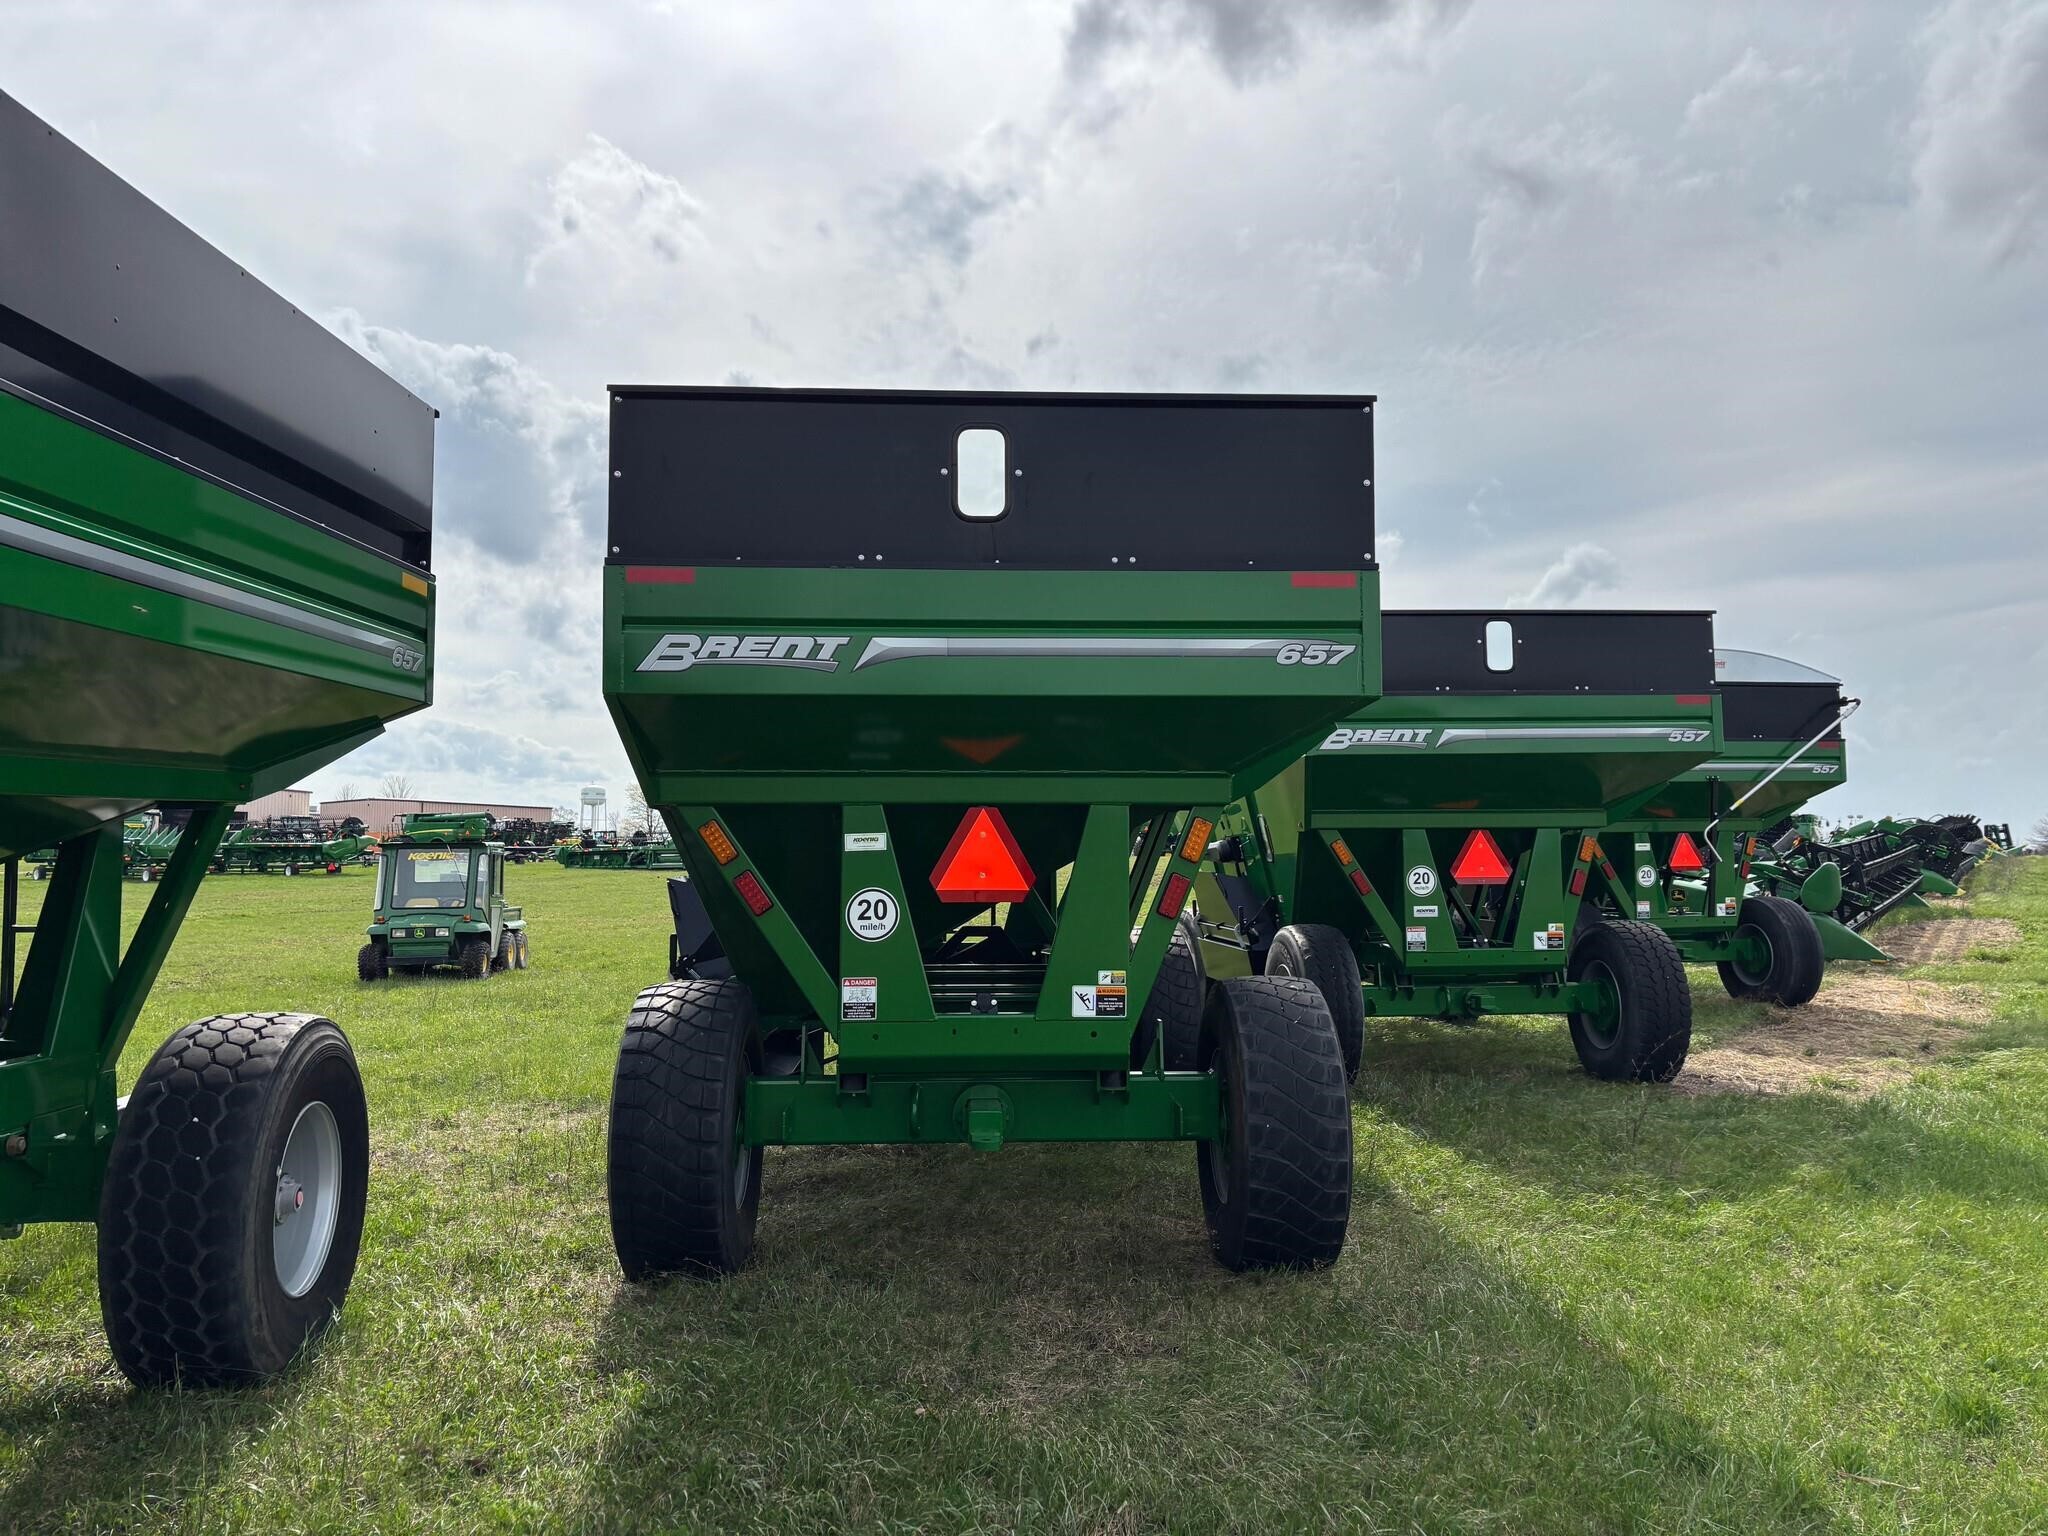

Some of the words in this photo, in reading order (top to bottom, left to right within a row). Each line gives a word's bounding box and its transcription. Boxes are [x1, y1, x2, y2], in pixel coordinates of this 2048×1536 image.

[392, 646, 425, 672] 657
[635, 634, 850, 672] BRENT
[1276, 643, 1357, 666] 657
[1319, 728, 1433, 750] BRENT
[1668, 730, 1711, 742] 557
[1812, 765, 1839, 774] 557
[1413, 872, 1430, 885] 20
[1640, 869, 1652, 879] 20
[857, 898, 888, 921] 20
[859, 923, 886, 931] mile/h
